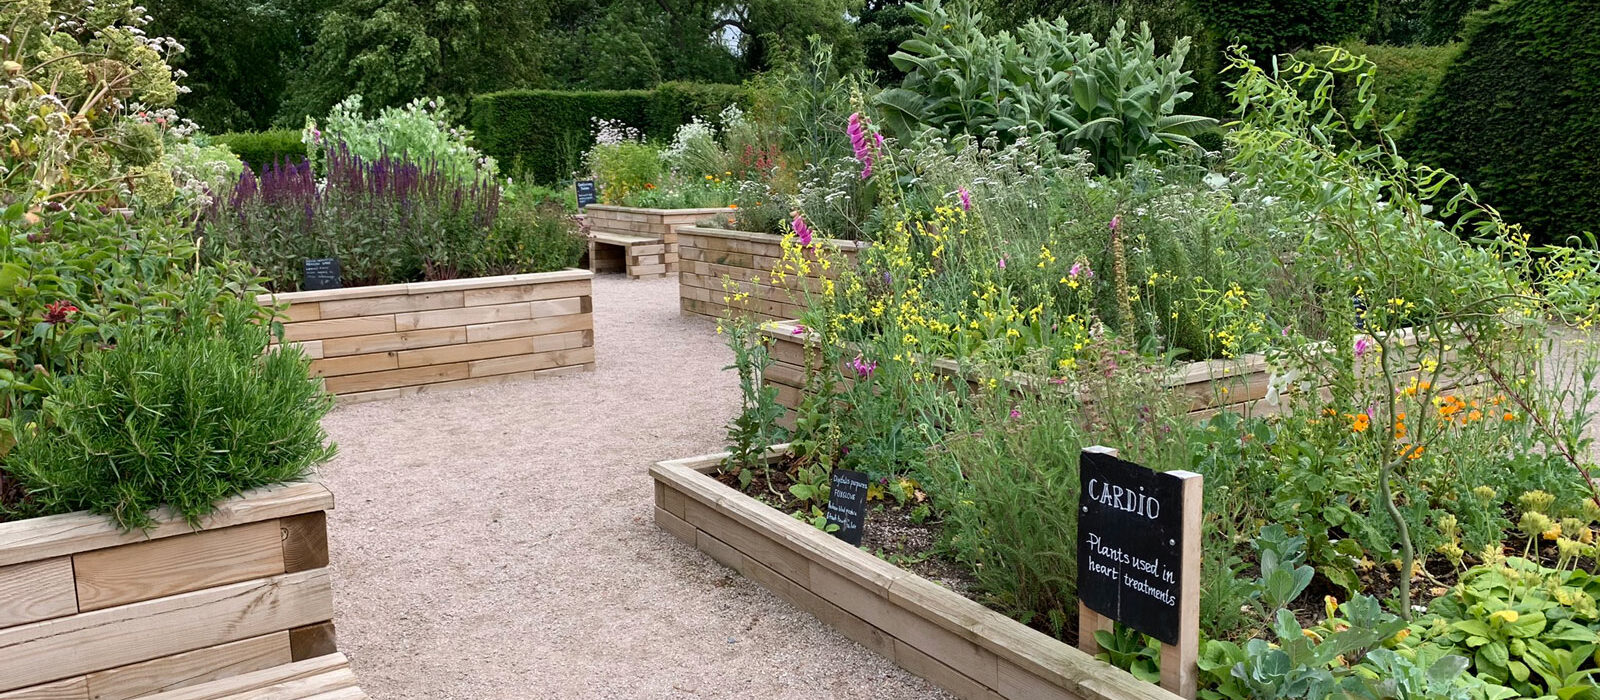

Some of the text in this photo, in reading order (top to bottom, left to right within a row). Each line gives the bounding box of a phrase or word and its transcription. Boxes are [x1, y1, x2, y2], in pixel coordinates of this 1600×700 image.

[834, 489, 856, 500] FOXGLOVE
[1088, 478, 1160, 519] CARDIO
[1086, 532, 1176, 584] Plants used in
[1088, 555, 1176, 606] heart treatments
